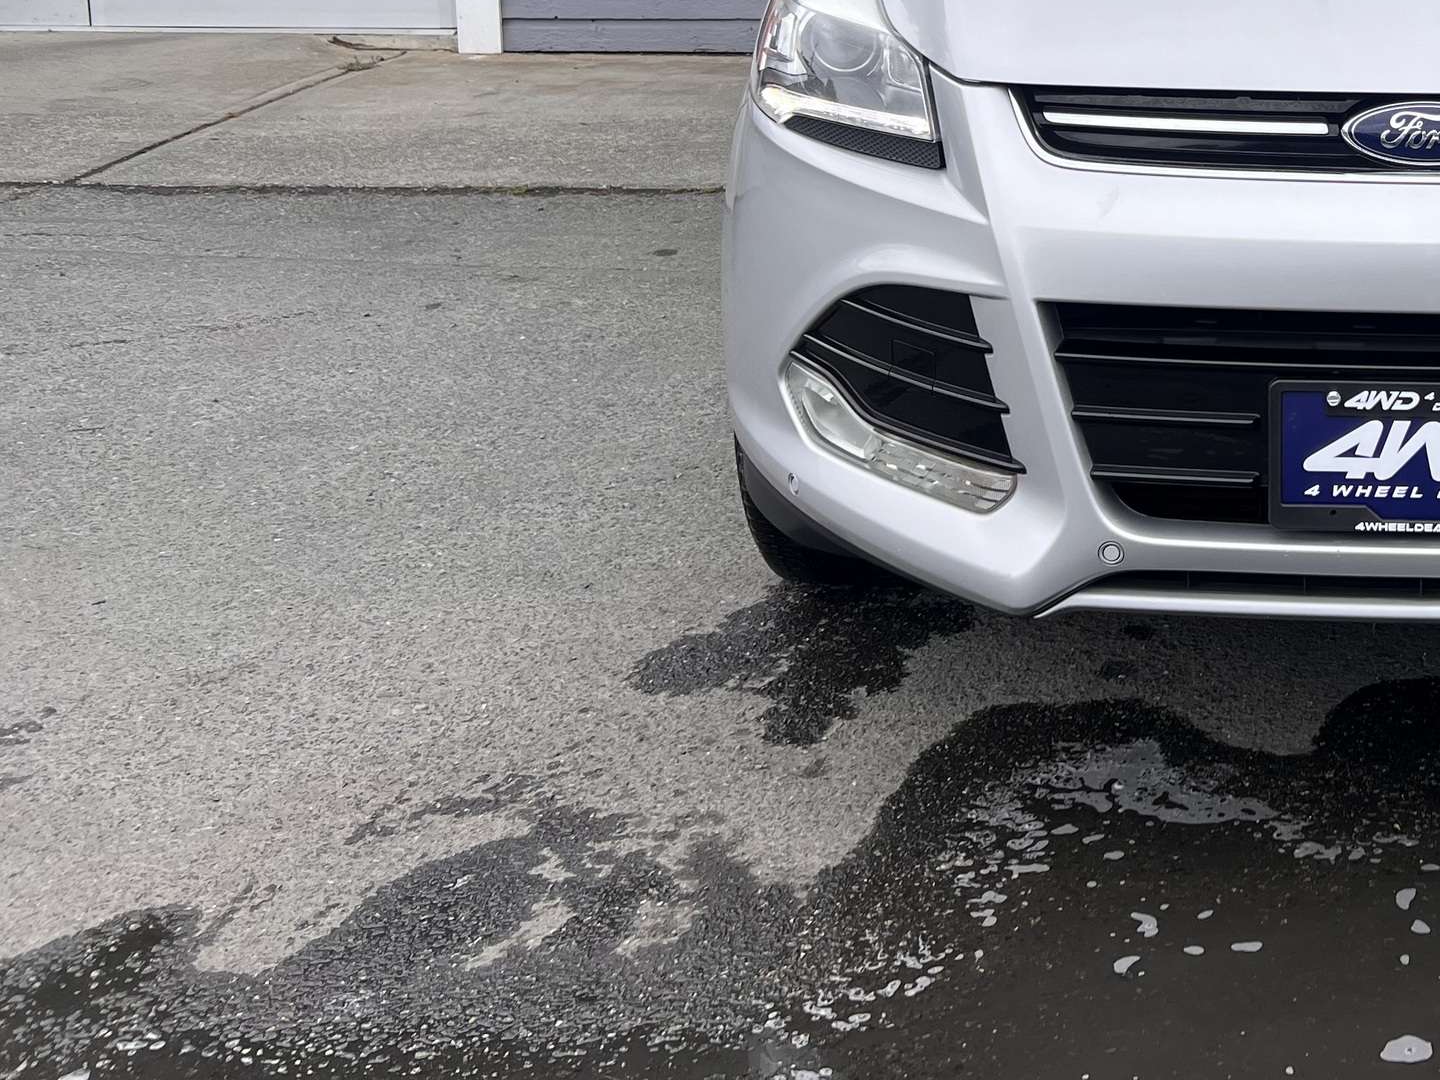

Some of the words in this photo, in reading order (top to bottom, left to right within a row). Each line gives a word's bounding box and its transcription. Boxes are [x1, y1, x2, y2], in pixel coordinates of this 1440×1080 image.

[1343, 390, 1421, 411] 4WD
[1423, 391, 1436, 402] 4
[1303, 483, 1322, 498] 4
[1331, 484, 1425, 500] WHEEL
